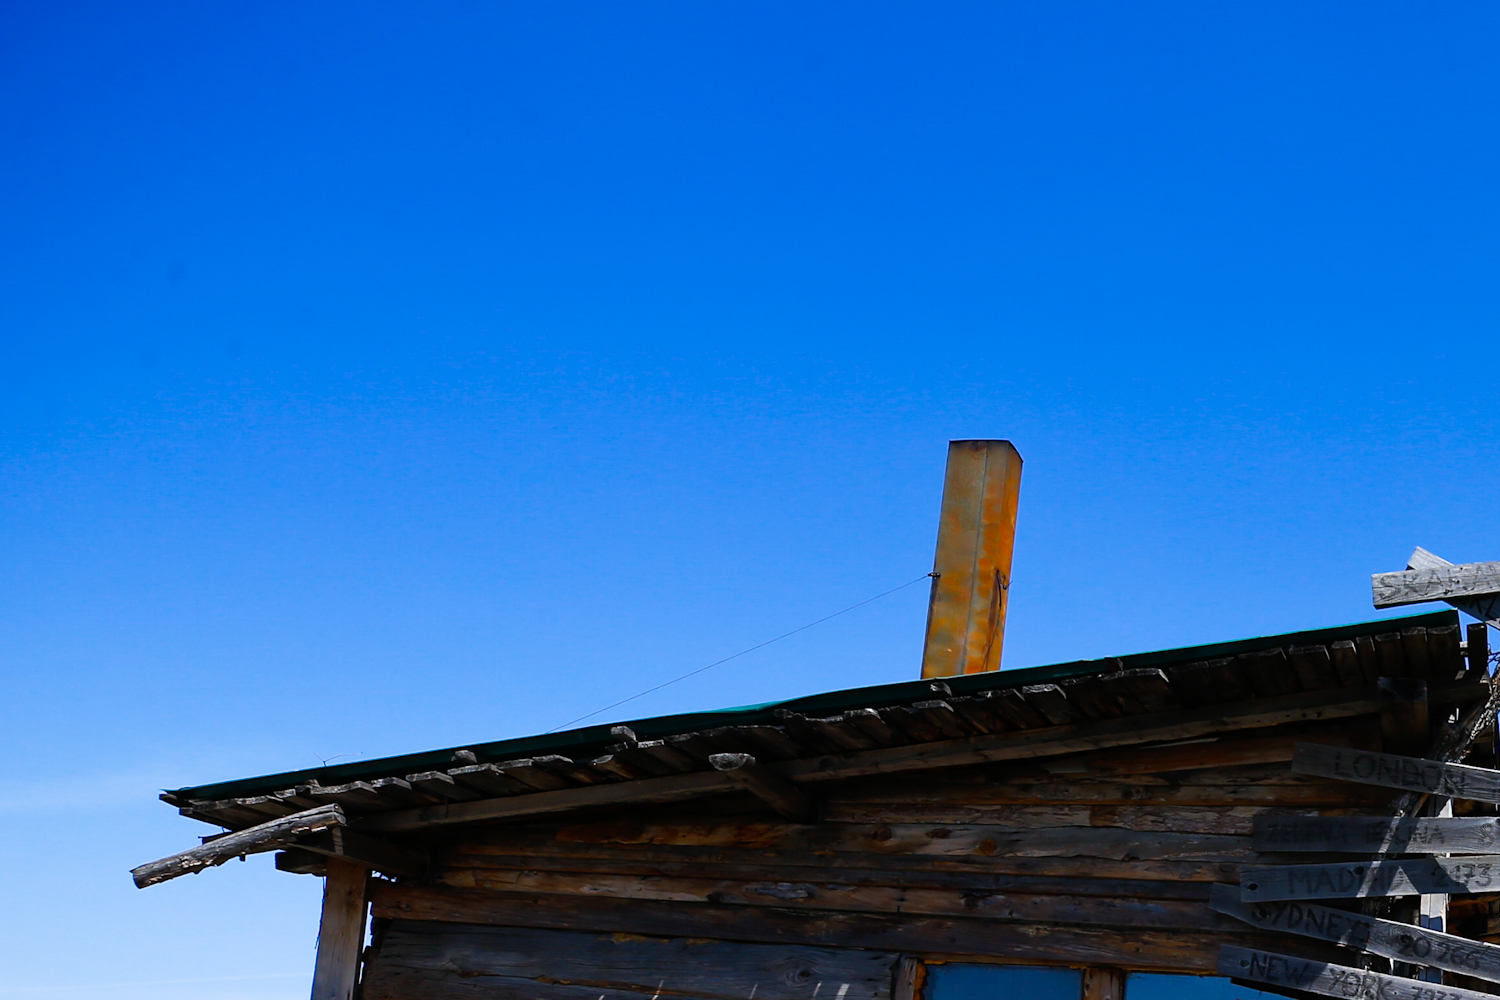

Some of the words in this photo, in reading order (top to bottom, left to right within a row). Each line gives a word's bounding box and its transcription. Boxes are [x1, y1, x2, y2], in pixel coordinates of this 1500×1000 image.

[1334, 751, 1466, 795] LONDON
[1288, 866, 1404, 895] MADRID
[1432, 863, 1494, 888] 2173
[1248, 952, 1311, 985] NEW
